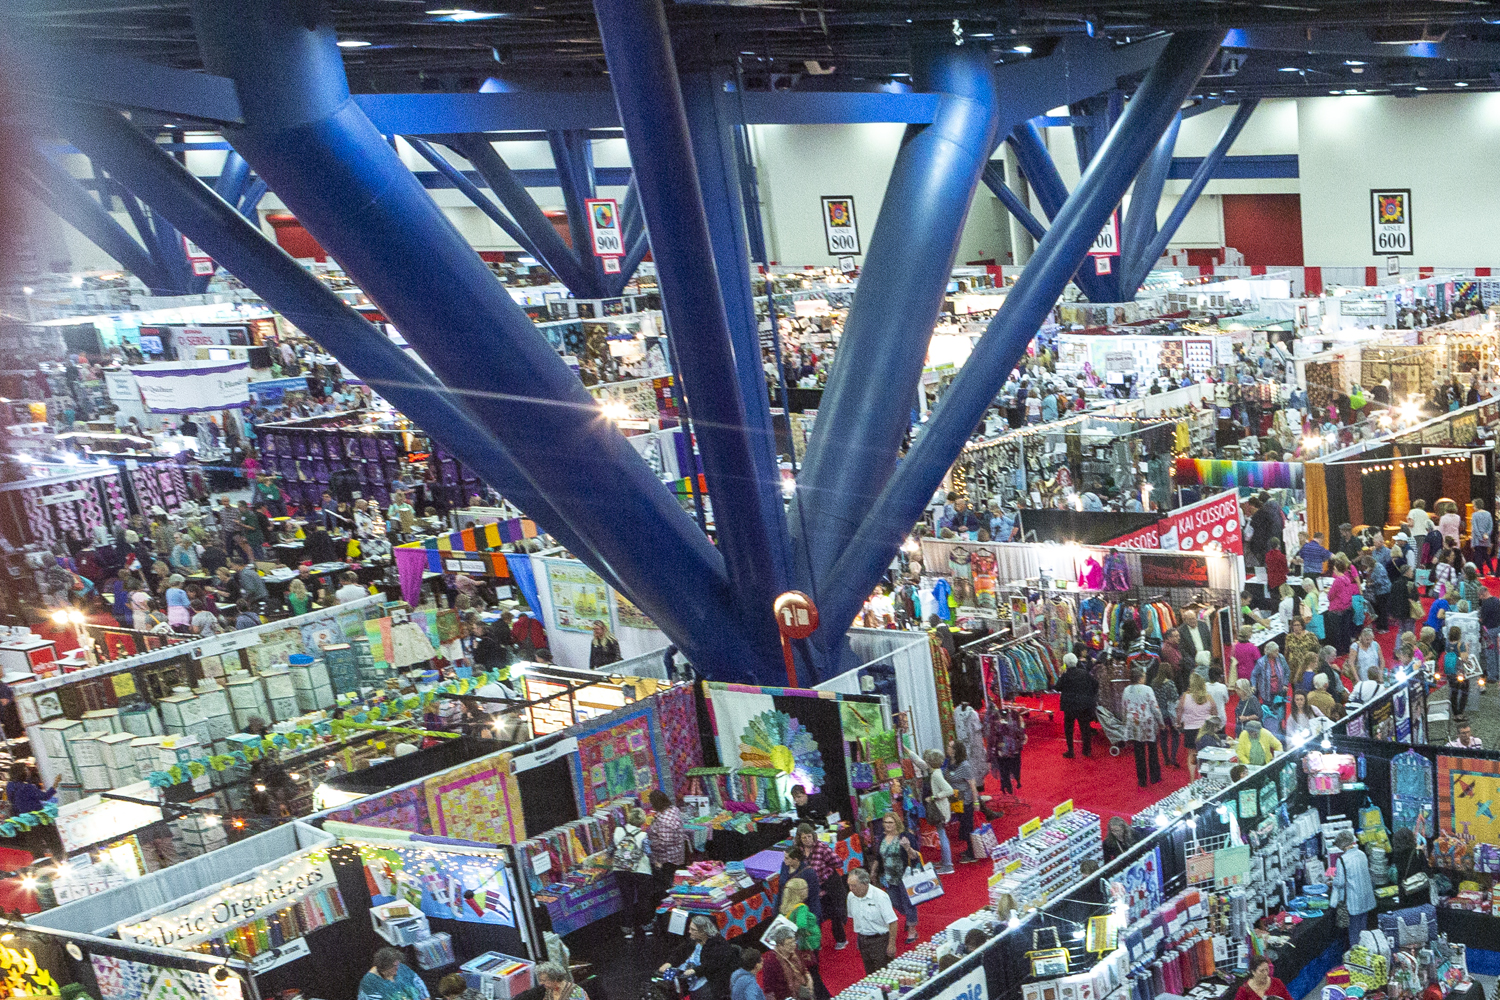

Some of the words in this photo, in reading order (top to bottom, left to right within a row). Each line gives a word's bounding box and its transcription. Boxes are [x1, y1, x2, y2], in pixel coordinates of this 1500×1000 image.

[597, 236, 619, 250] 900
[831, 235, 855, 250] 800
[1379, 233, 1406, 249] 600
[1179, 515, 1194, 534] KAI
[1195, 499, 1236, 528] SCISSORS
[212, 866, 325, 924] Organizers
